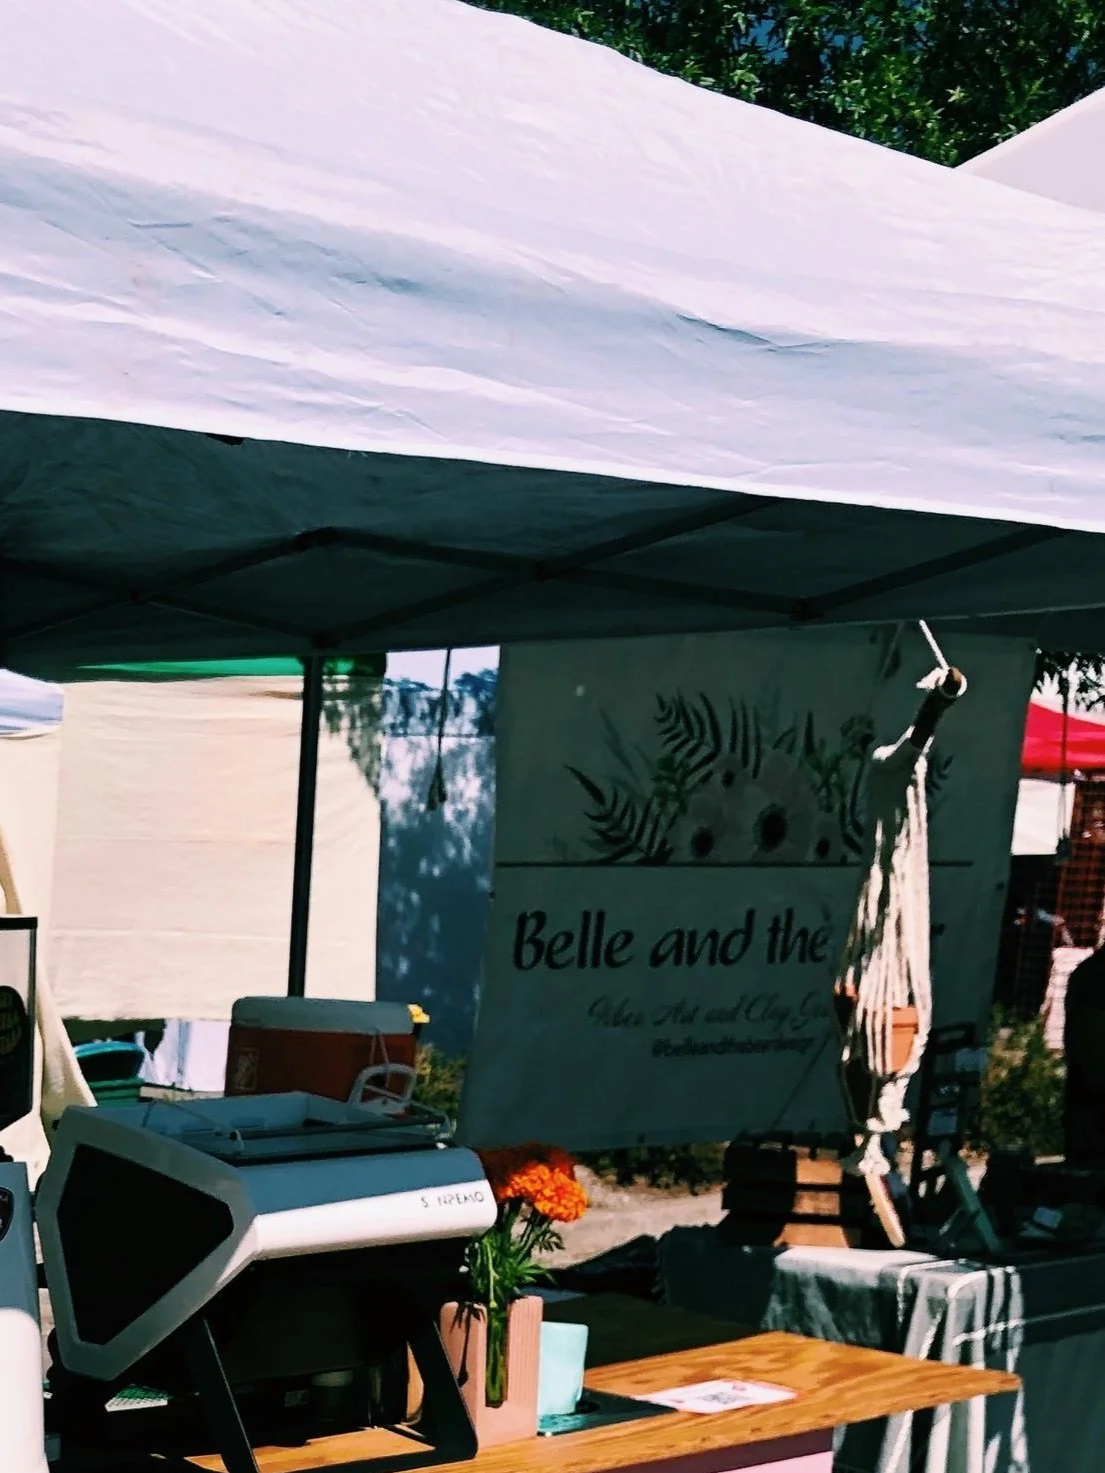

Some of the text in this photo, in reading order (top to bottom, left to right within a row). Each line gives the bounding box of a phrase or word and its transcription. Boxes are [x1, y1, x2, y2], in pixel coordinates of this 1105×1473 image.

[514, 909, 634, 970] Belle
[648, 908, 755, 969] and
[767, 907, 829, 965] the
[420, 1191, 484, 1208] SNREMO
